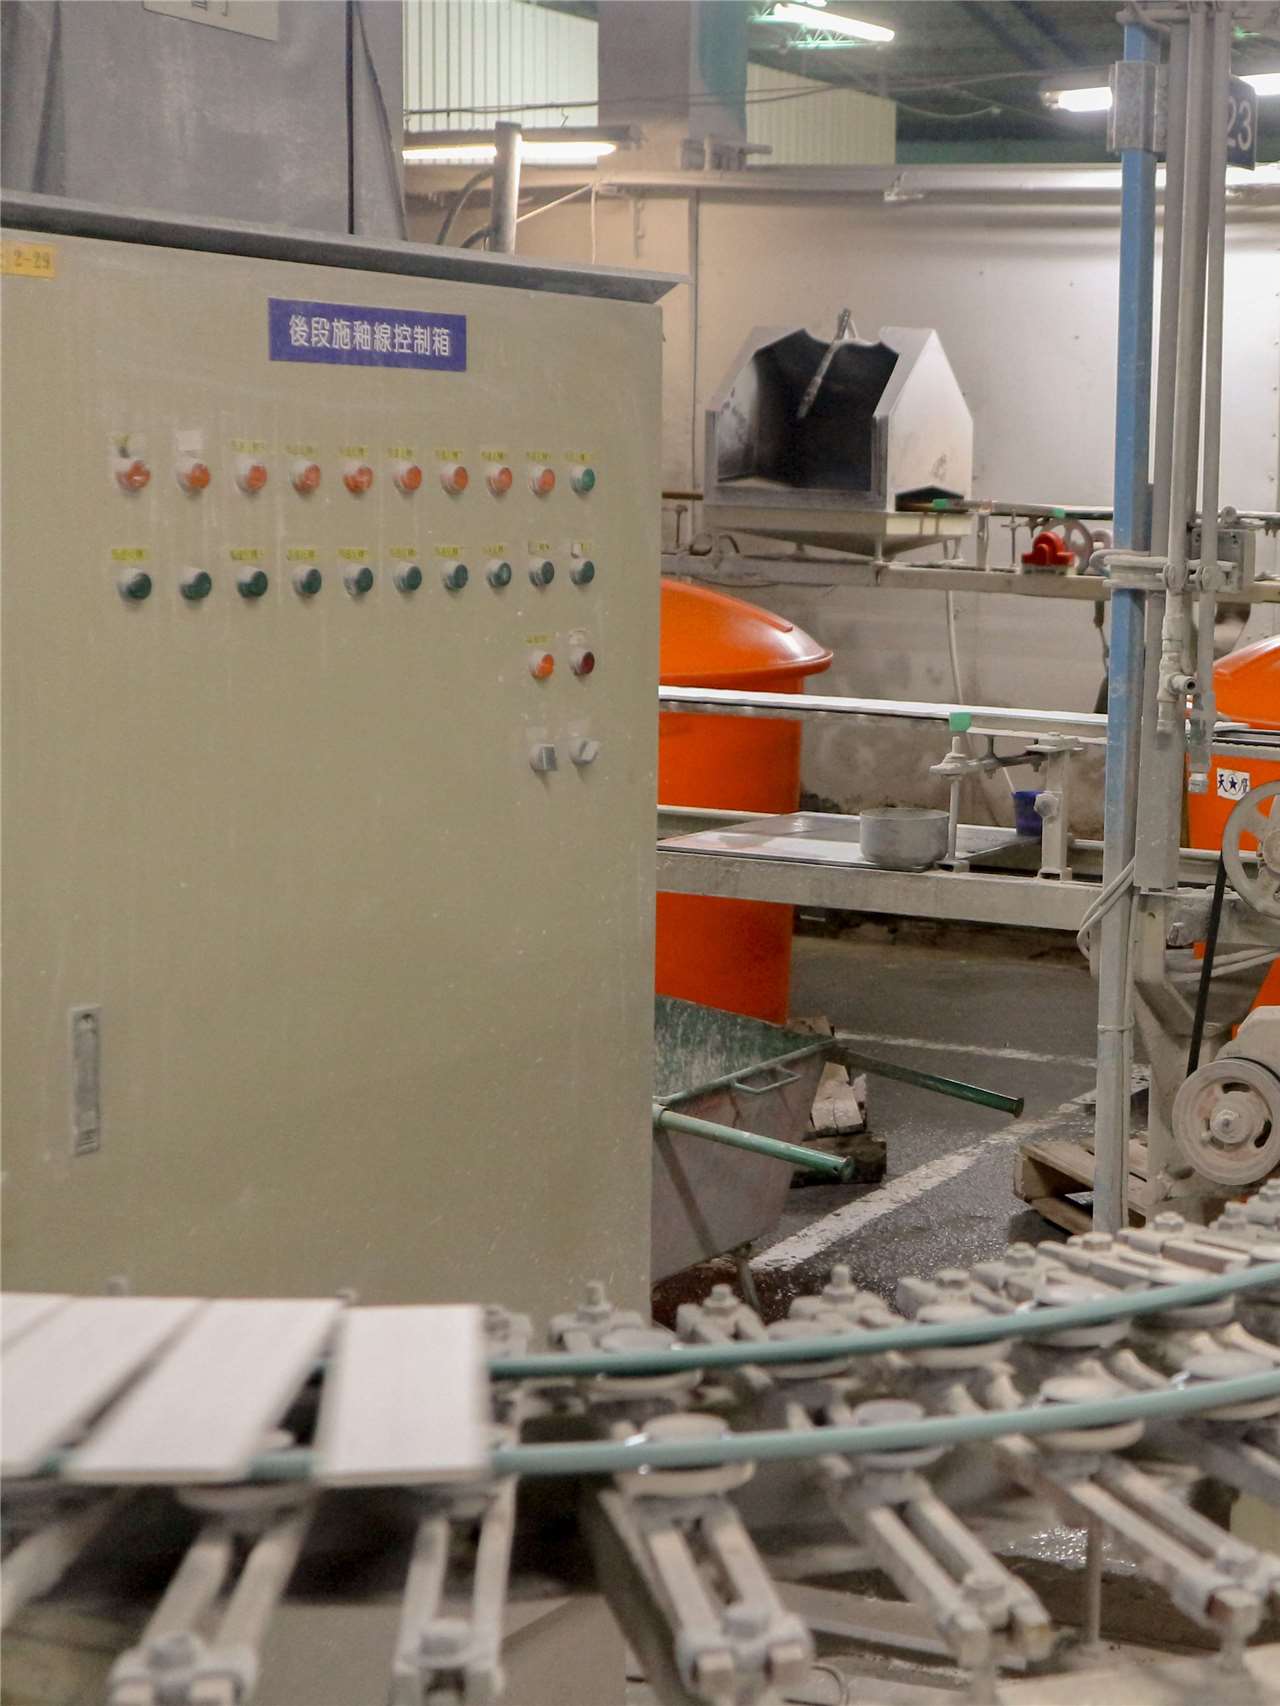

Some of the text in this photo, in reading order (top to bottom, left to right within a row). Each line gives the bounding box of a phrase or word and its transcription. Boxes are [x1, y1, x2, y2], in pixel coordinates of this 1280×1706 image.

[1226, 95, 1252, 151] 23
[289, 314, 451, 357] 後段施釉線控制箱
